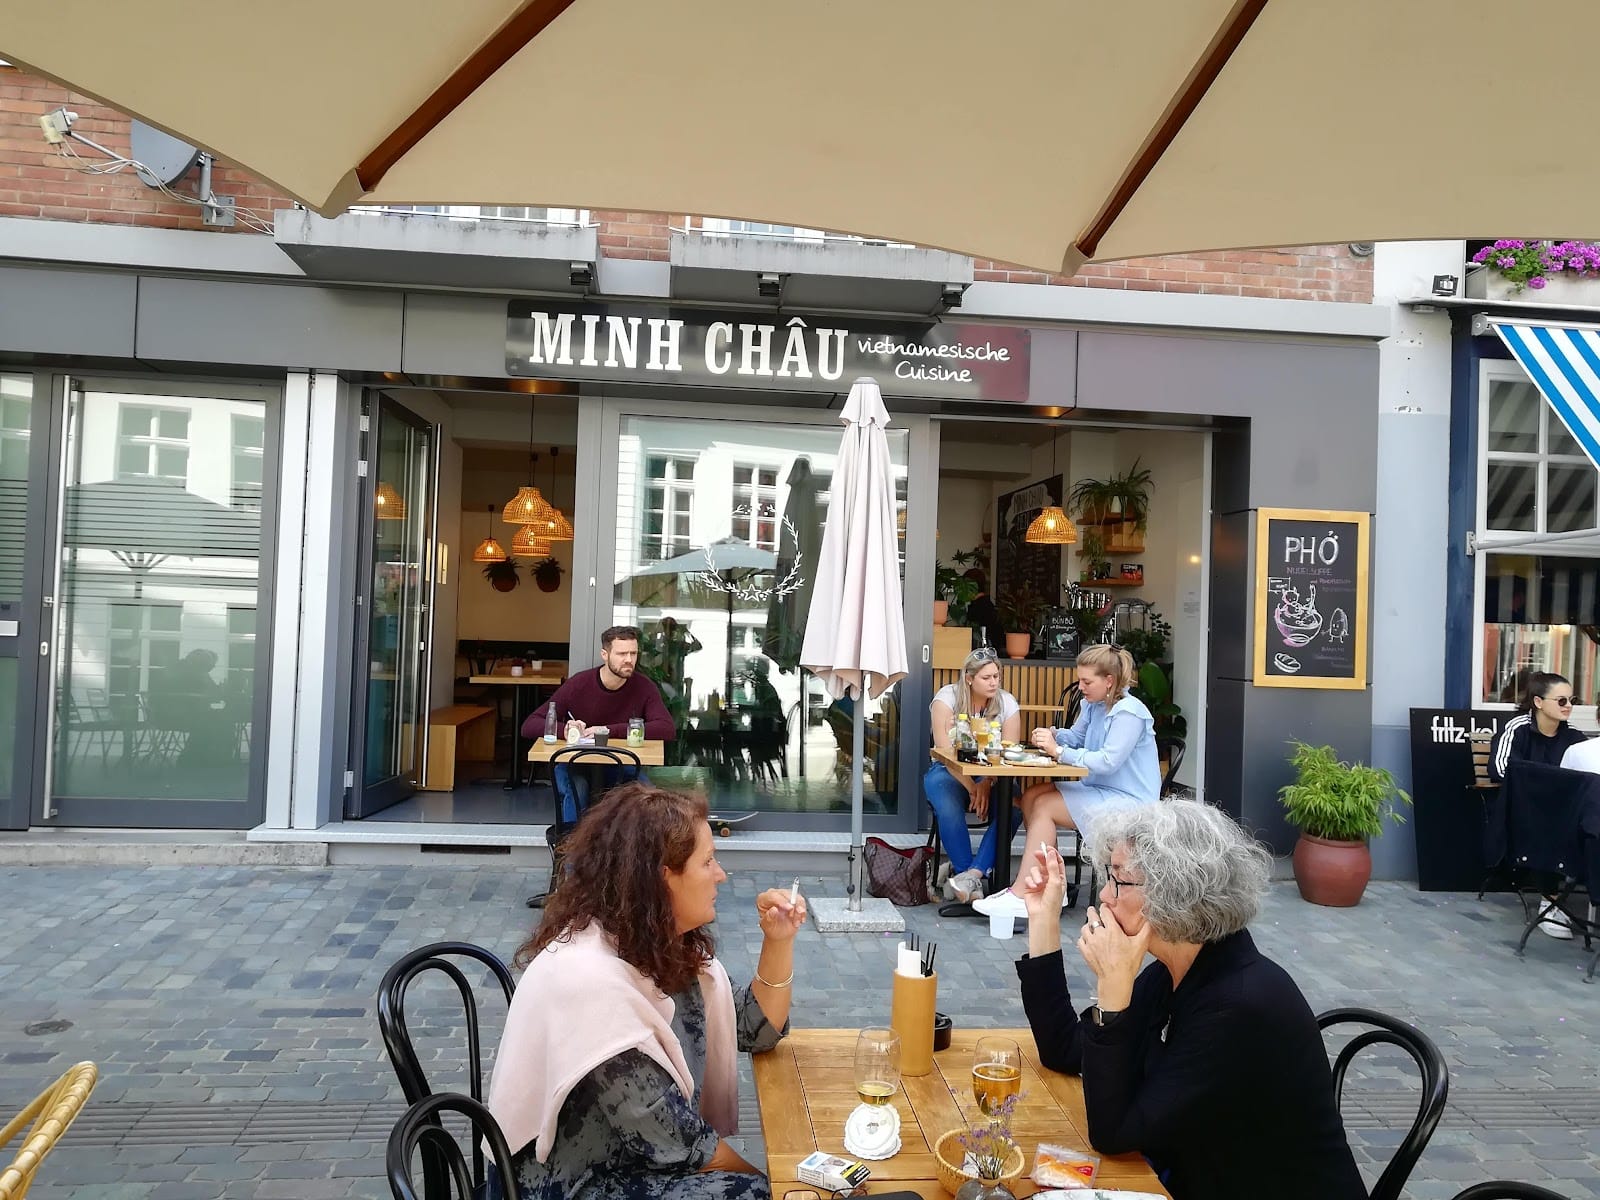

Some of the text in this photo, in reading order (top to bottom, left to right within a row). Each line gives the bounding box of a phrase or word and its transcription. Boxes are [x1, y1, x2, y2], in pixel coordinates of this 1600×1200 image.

[529, 311, 848, 380] MINH CHÂU
[858, 336, 1010, 361] vietnamesische
[895, 360, 973, 382] Cuisine
